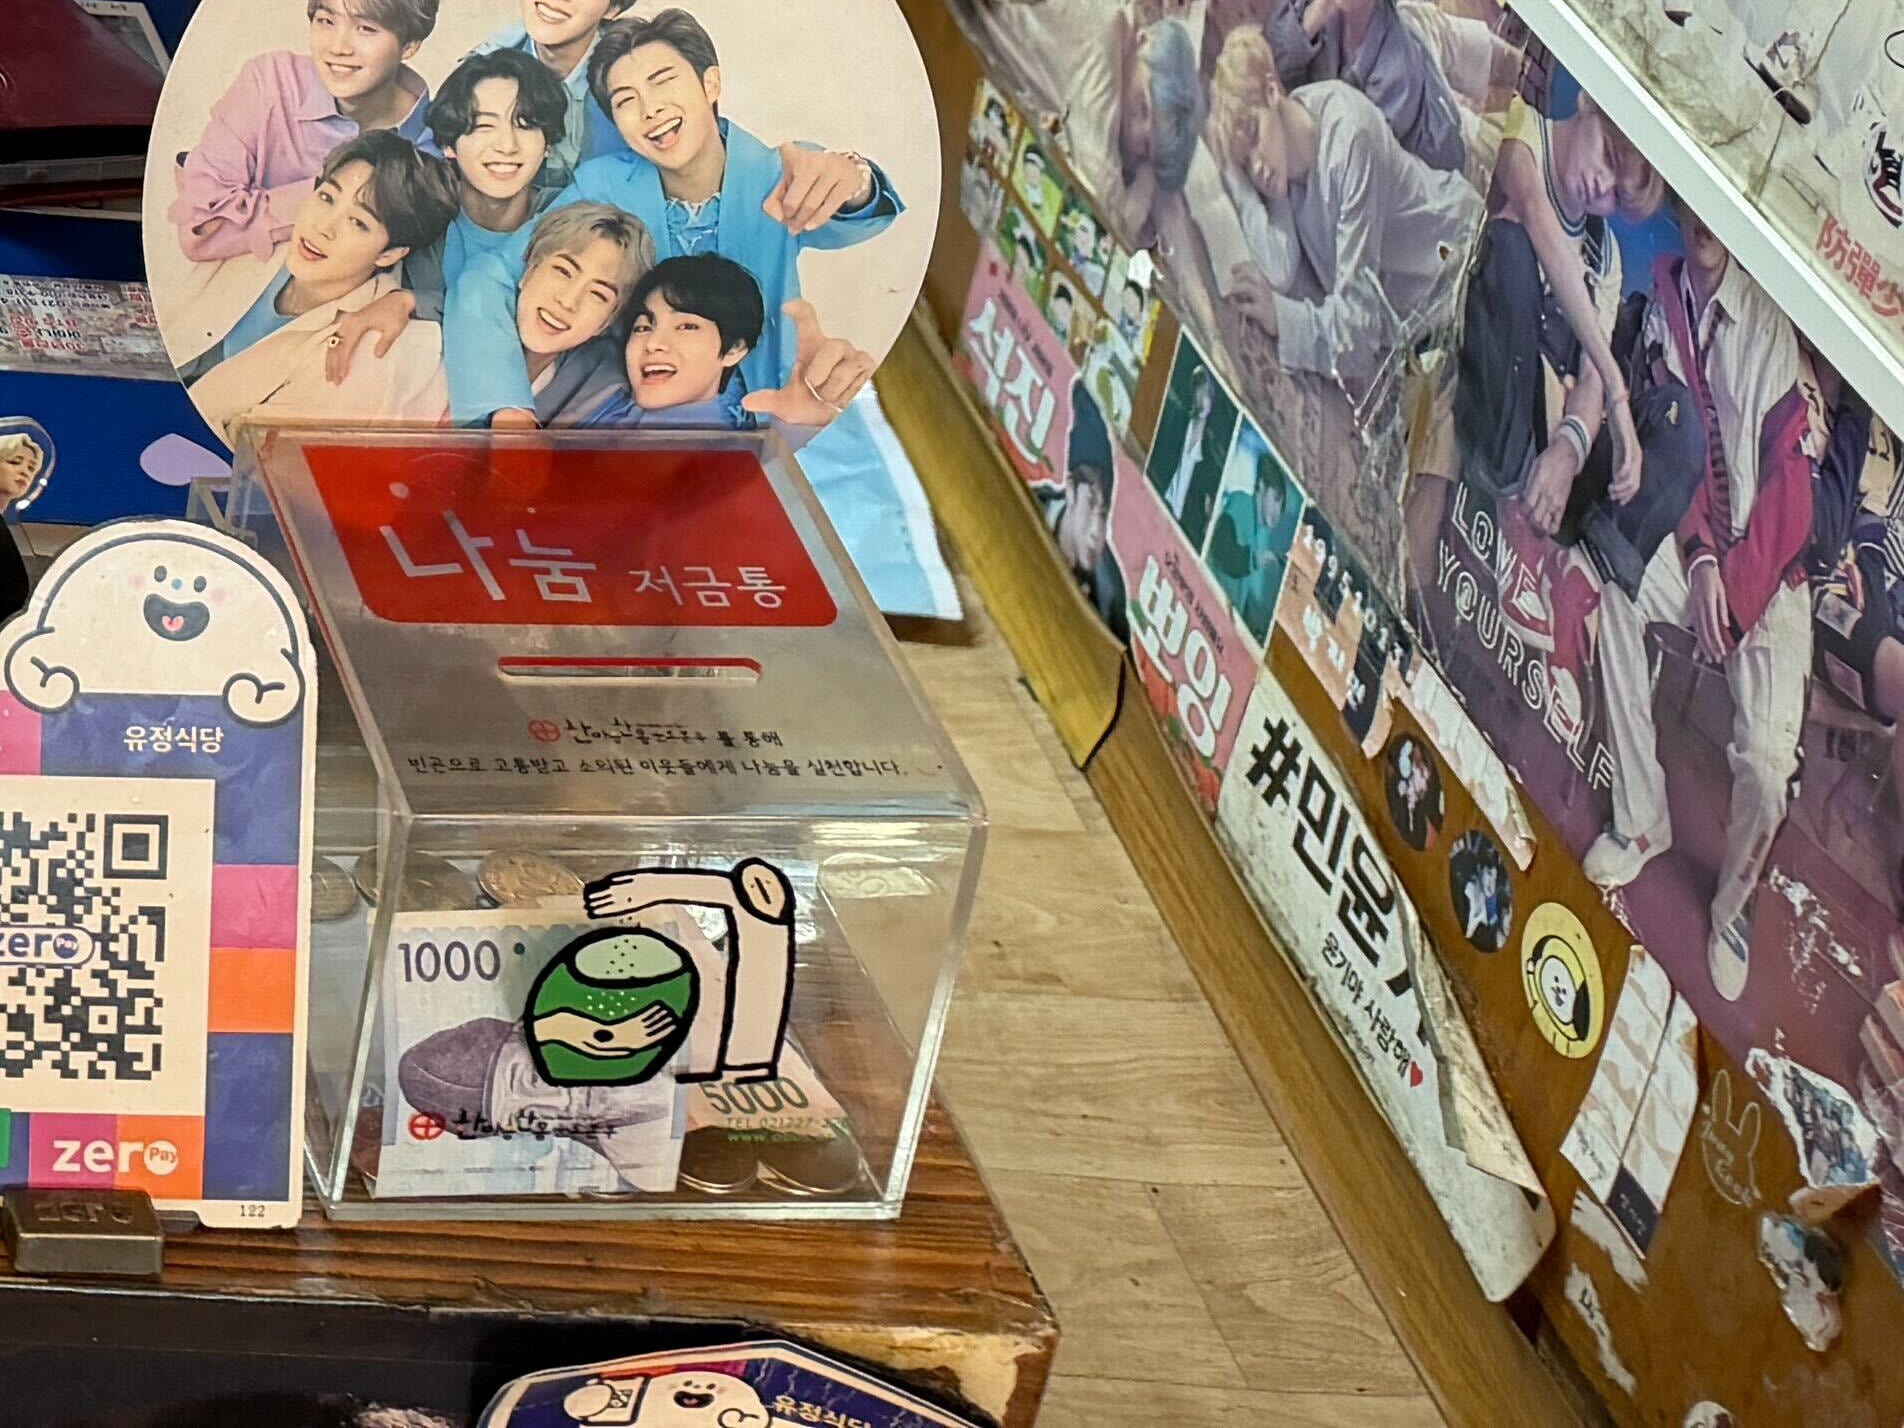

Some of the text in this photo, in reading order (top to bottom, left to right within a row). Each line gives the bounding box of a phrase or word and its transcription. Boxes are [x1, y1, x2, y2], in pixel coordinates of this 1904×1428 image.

[379, 507, 787, 610] 나눔 저금통
[1452, 481, 1540, 609] LOVE
[1436, 539, 1614, 792] YOURSELF
[123, 725, 224, 754] 유정식당
[408, 756, 487, 775] 빈곤으로
[494, 756, 568, 776] 고통받고
[580, 756, 632, 776] 소외된
[399, 940, 500, 983] 1000
[699, 1076, 809, 1115] 5000
[240, 1204, 266, 1219] 122
